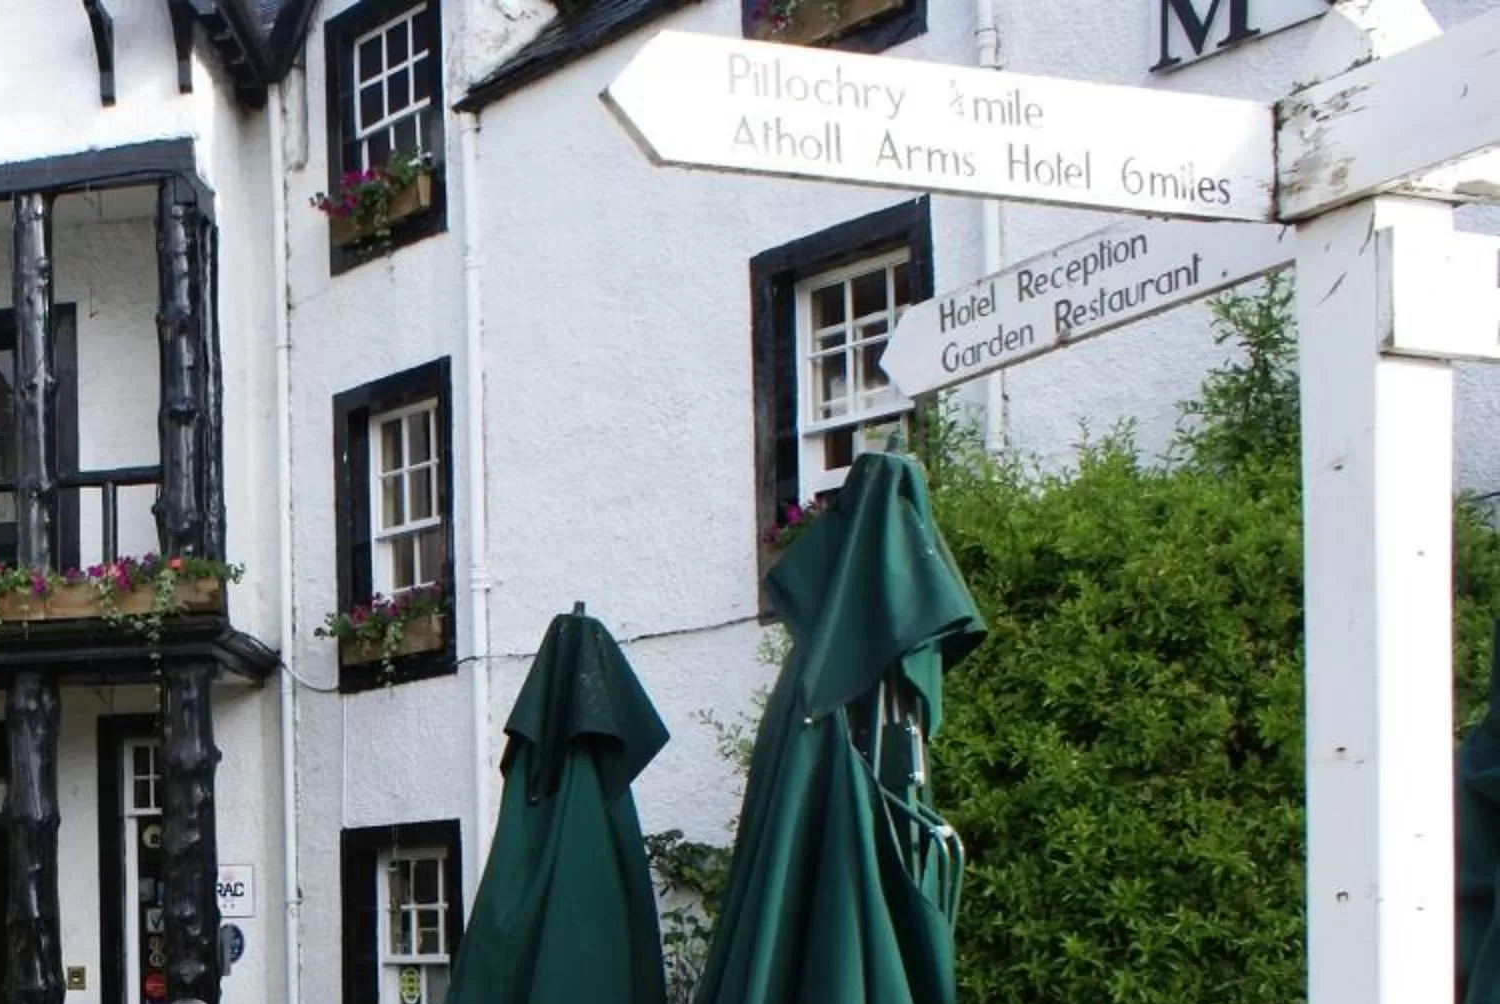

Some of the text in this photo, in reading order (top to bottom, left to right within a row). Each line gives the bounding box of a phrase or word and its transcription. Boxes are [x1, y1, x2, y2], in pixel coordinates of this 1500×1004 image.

[733, 115, 841, 164] Atholl
[876, 129, 976, 177] Arms
[1008, 143, 1091, 189] Hotel
[938, 234, 1147, 332] Hotel Reception
[941, 253, 1201, 373] Garden Restaurant
